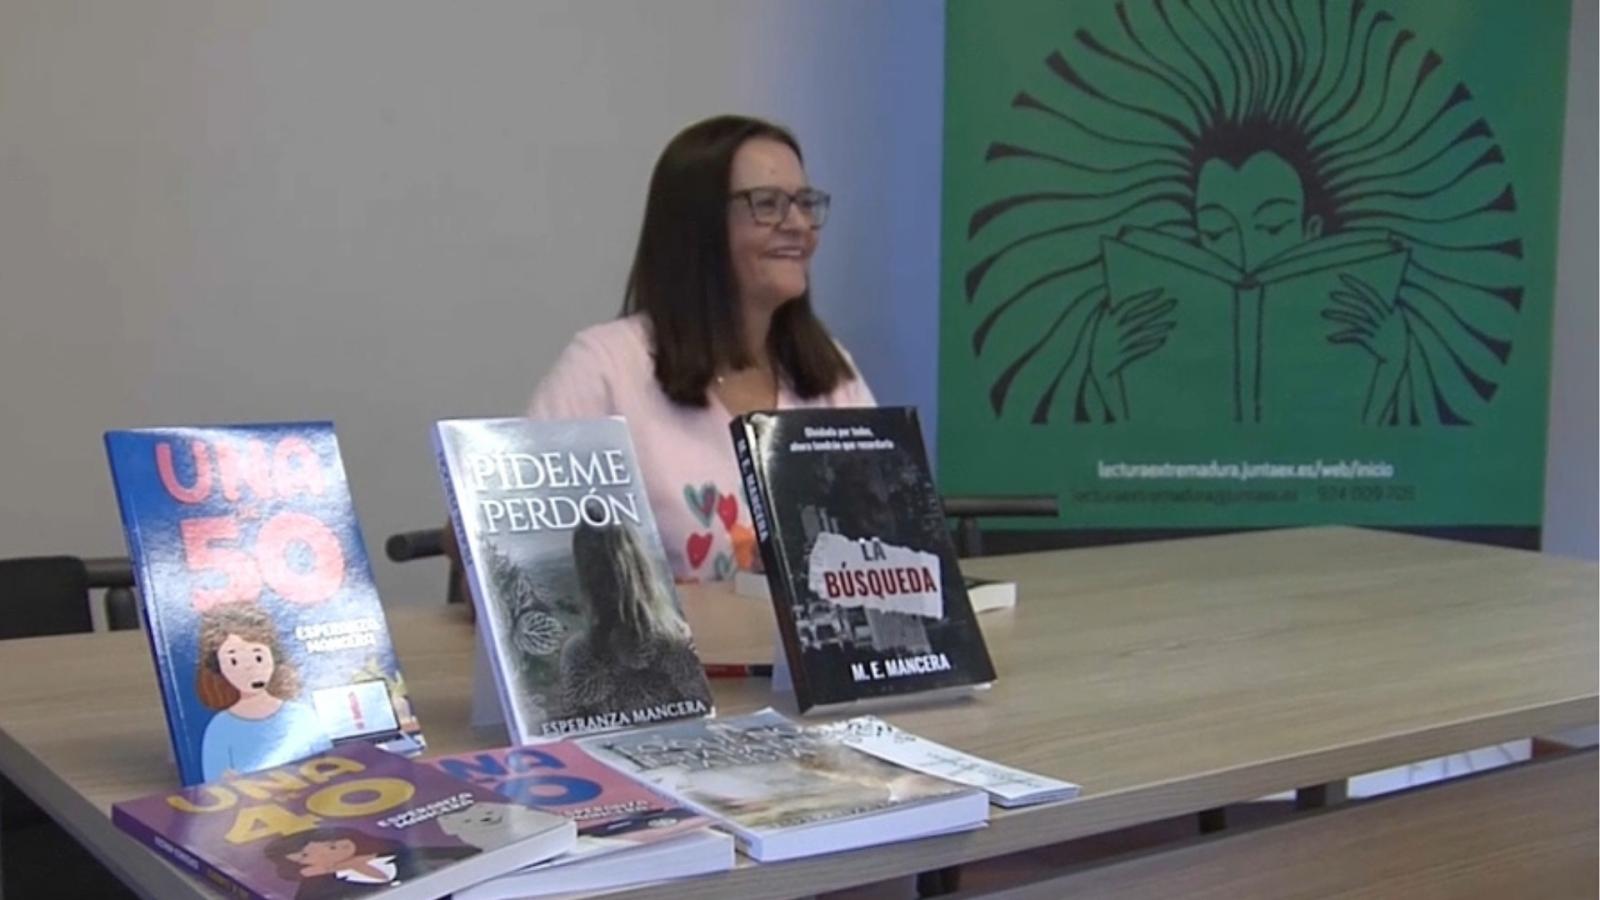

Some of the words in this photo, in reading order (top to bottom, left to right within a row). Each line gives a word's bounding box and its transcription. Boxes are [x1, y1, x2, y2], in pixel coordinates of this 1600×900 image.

[842, 441, 856, 452] que
[155, 437, 326, 505] UNA
[466, 450, 631, 492] PÍDEME
[1098, 460, 1394, 482] lecturaextremadura.juntaex.es/web/inicio
[480, 488, 642, 534] PERDÓN
[746, 473, 769, 543] MANCERA
[180, 511, 347, 613] 50
[857, 537, 887, 562] LA
[824, 561, 938, 600] BÚSQUEDA
[851, 663, 871, 683] M.
[870, 660, 886, 680] E.
[884, 653, 952, 678] MANCERA
[542, 711, 631, 737] ESPERANZA
[632, 699, 706, 723] MANCERA
[167, 757, 366, 813] UNA
[438, 748, 567, 783] NA
[224, 778, 415, 844] 40
